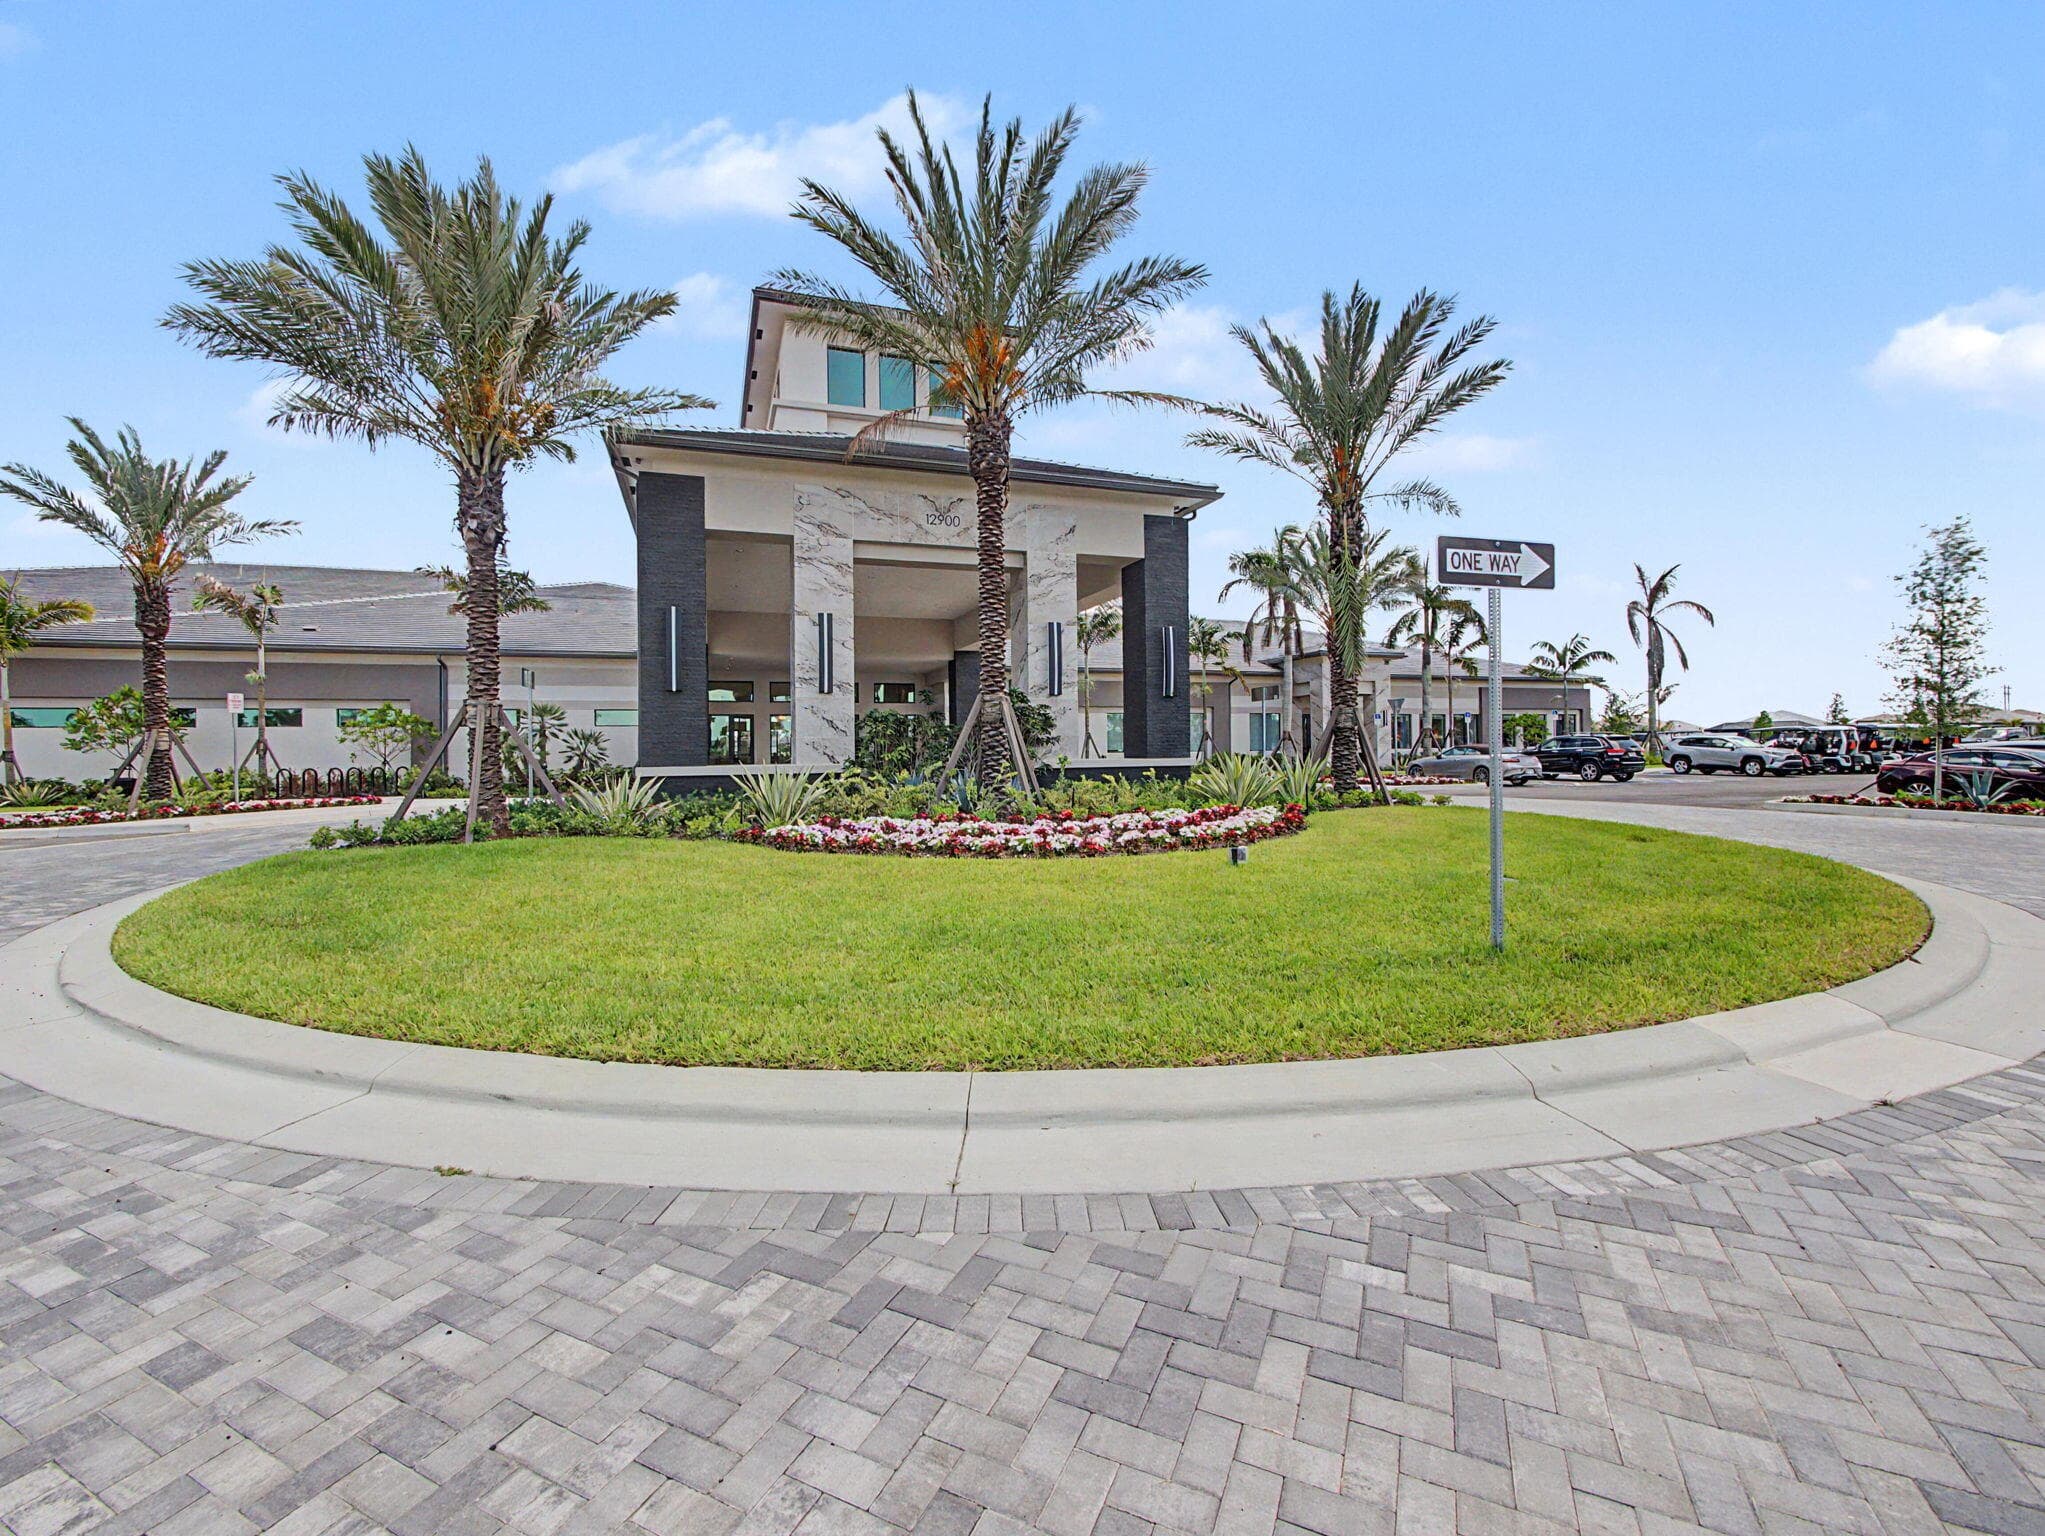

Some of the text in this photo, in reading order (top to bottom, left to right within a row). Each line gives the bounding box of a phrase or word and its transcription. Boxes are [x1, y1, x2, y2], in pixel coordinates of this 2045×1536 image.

[926, 513, 961, 527] 12900
[1450, 551, 1521, 573] ONE WAY
